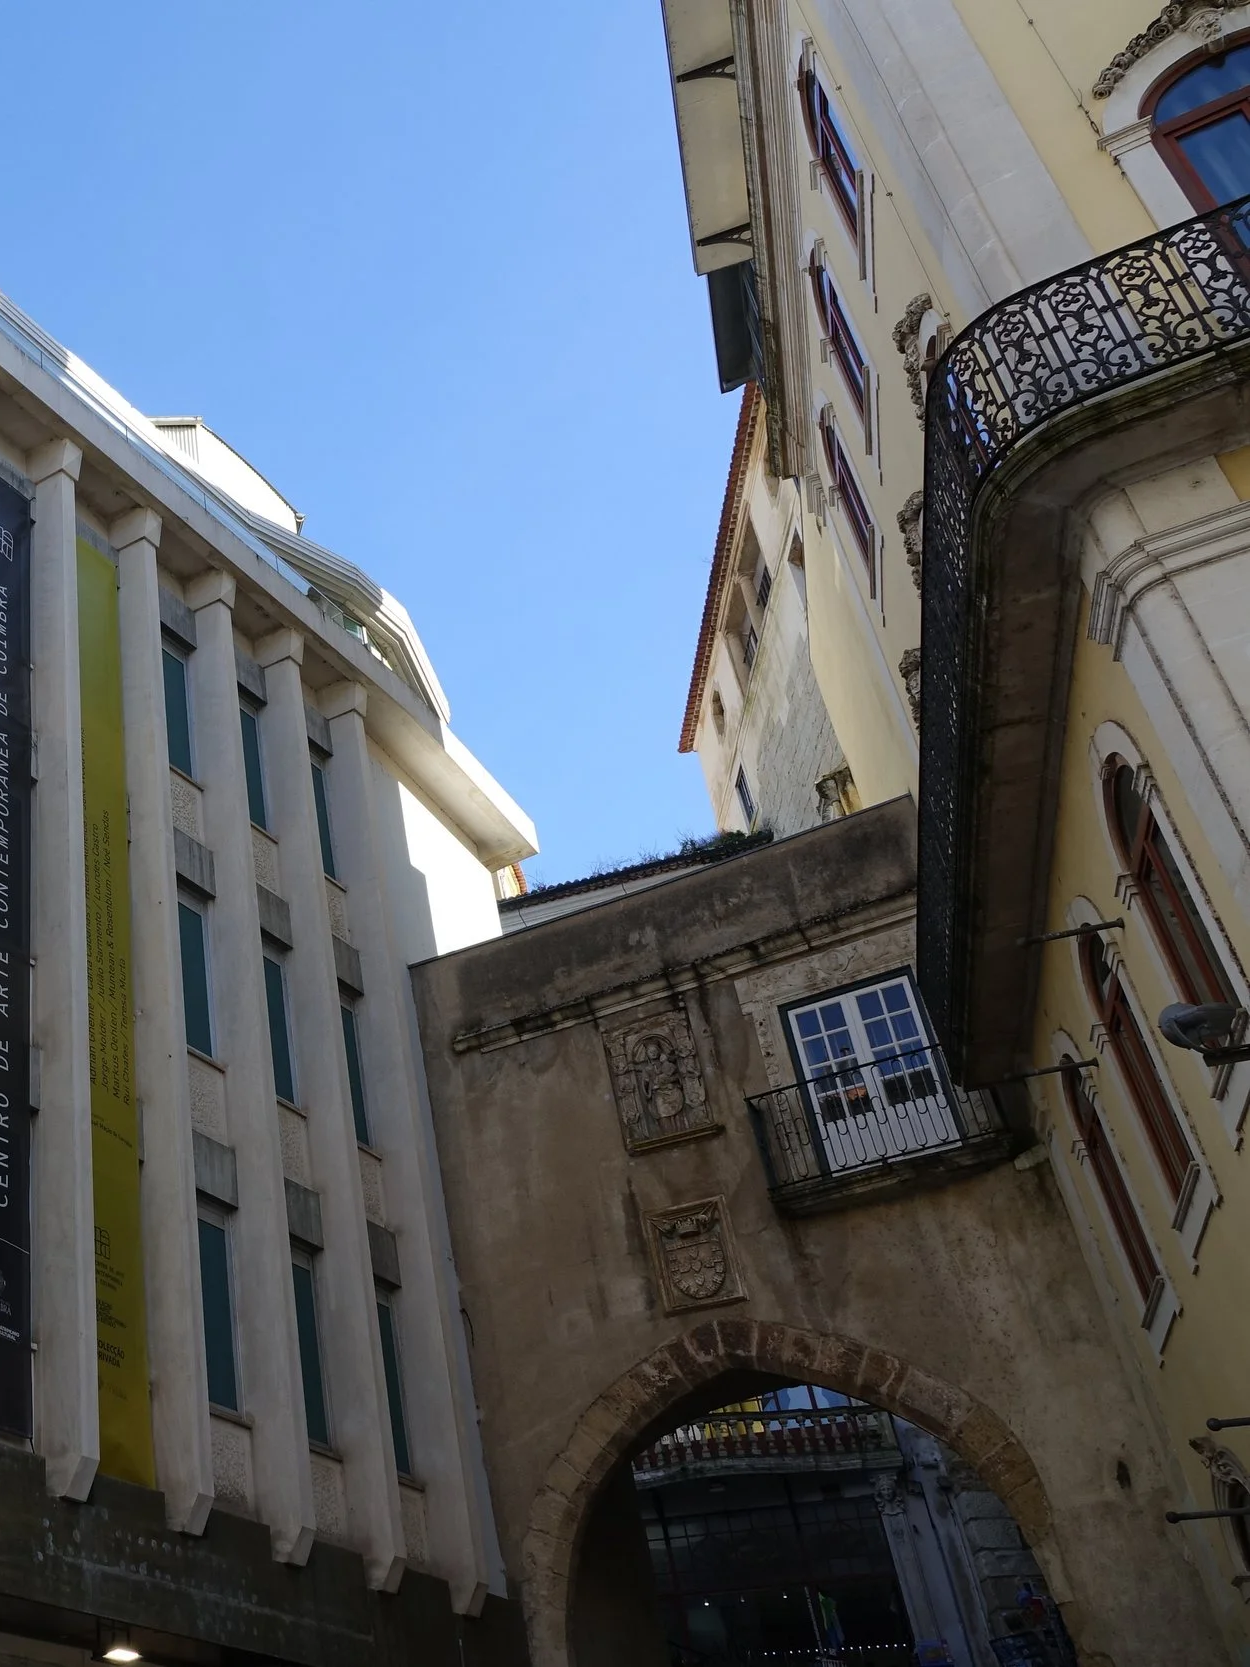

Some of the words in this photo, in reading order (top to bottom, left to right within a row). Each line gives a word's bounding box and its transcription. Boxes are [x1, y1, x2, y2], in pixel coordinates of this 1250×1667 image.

[91, 823, 100, 857] Castro
[101, 809, 111, 846] Sendas
[92, 859, 102, 901] Lourdes
[103, 879, 114, 937] Rosenblum
[94, 912, 104, 965] Sarmento
[107, 952, 117, 1000] Muntean
[118, 958, 127, 990] Murta
[118, 993, 128, 1030] Teresa
[98, 1014, 107, 1054] Molder
[109, 1012, 119, 1052] Oehlen
[100, 1057, 110, 1092] Jorge
[109, 1055, 121, 1099] Markus
[120, 1044, 130, 1083] Chafes
[121, 1086, 131, 1106] Rui
[97, 1338, 125, 1360] OLECÇÃO
[98, 1351, 120, 1368] RIVADA
